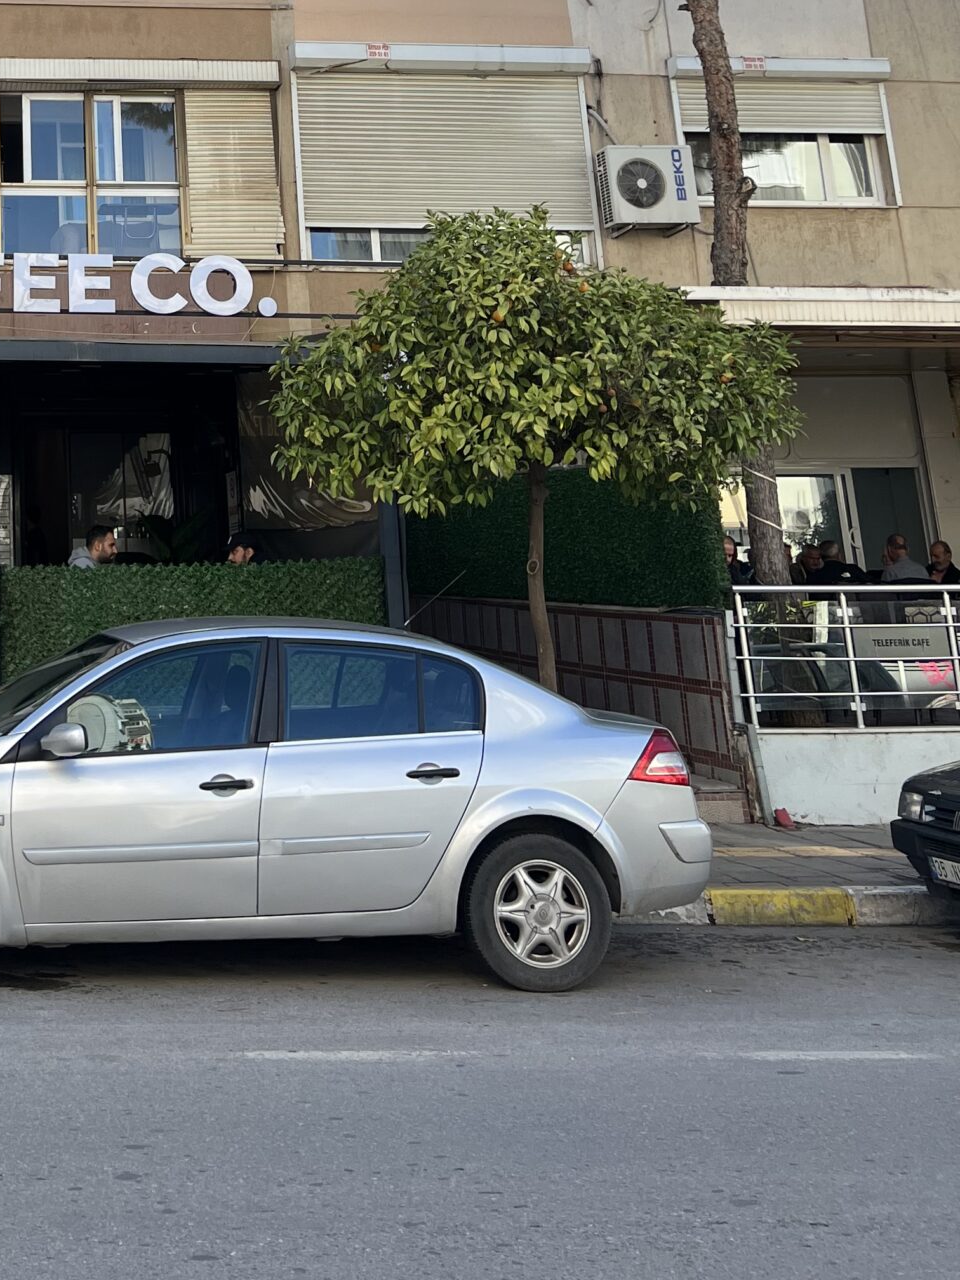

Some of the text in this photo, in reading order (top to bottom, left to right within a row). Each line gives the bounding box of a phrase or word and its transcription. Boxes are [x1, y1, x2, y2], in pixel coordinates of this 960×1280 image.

[671, 149, 687, 201] BEKO
[130, 252, 278, 317] CO.
[911, 638, 931, 648] CAFE
[934, 859, 948, 878] 35
